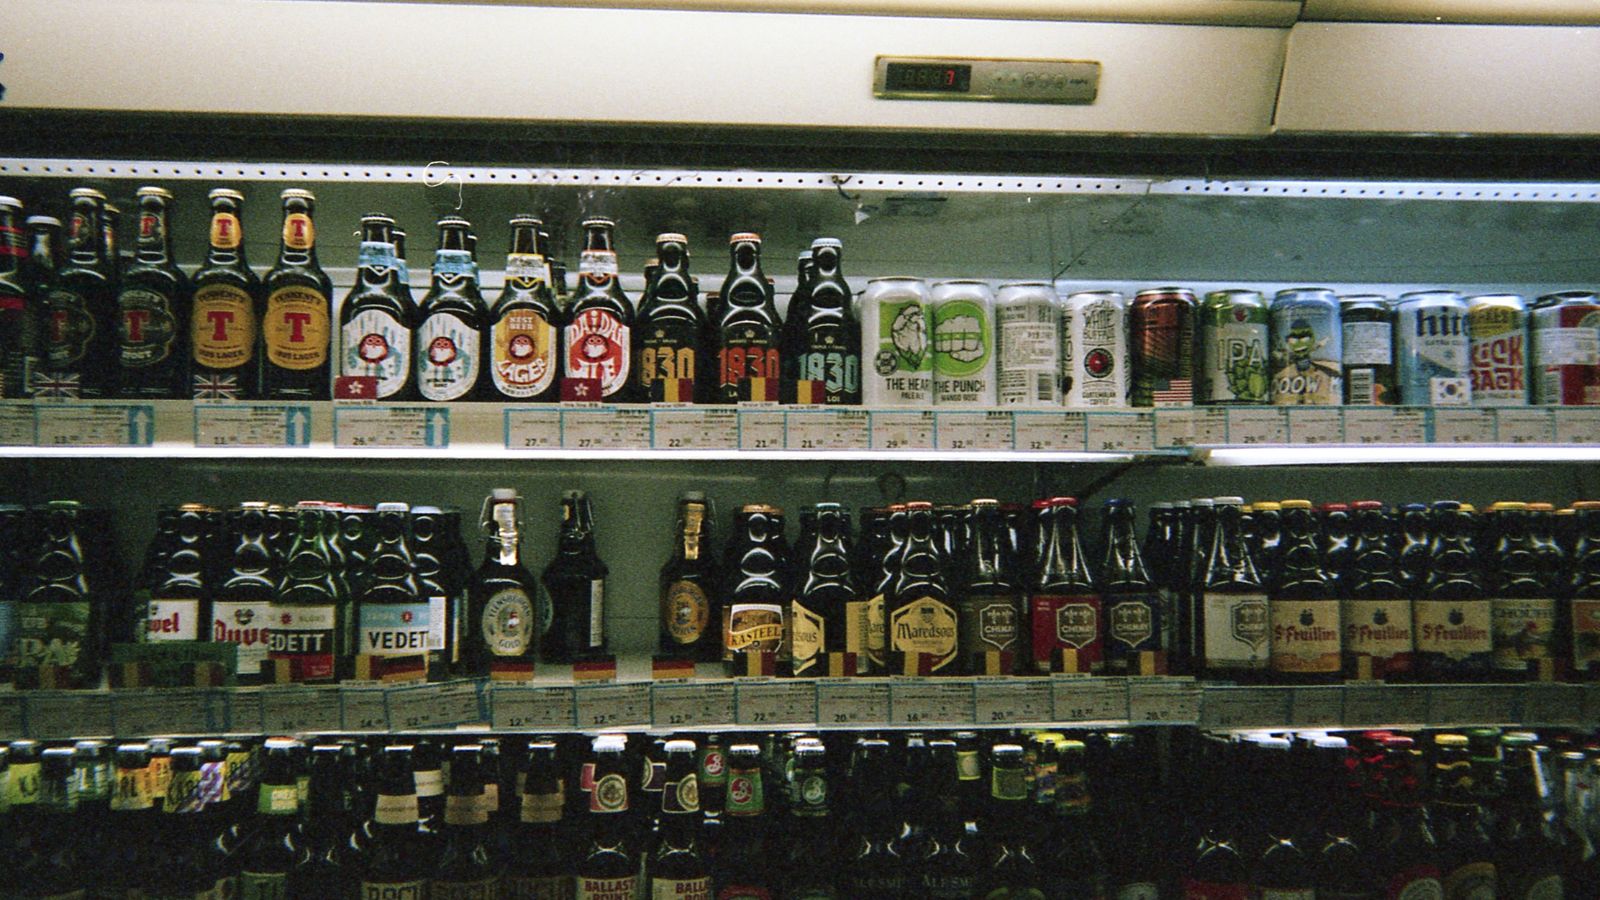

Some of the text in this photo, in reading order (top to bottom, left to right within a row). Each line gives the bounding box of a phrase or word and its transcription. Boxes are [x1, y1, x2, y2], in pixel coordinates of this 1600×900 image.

[216, 218, 232, 237] T
[290, 219, 306, 238] T
[122, 310, 151, 342] T
[207, 310, 235, 341] T
[284, 312, 311, 343] T
[1216, 337, 1265, 372] IPA
[885, 378, 907, 391] THE
[933, 380, 986, 393] THE PUNCH
[731, 626, 781, 648] KASTEEL
